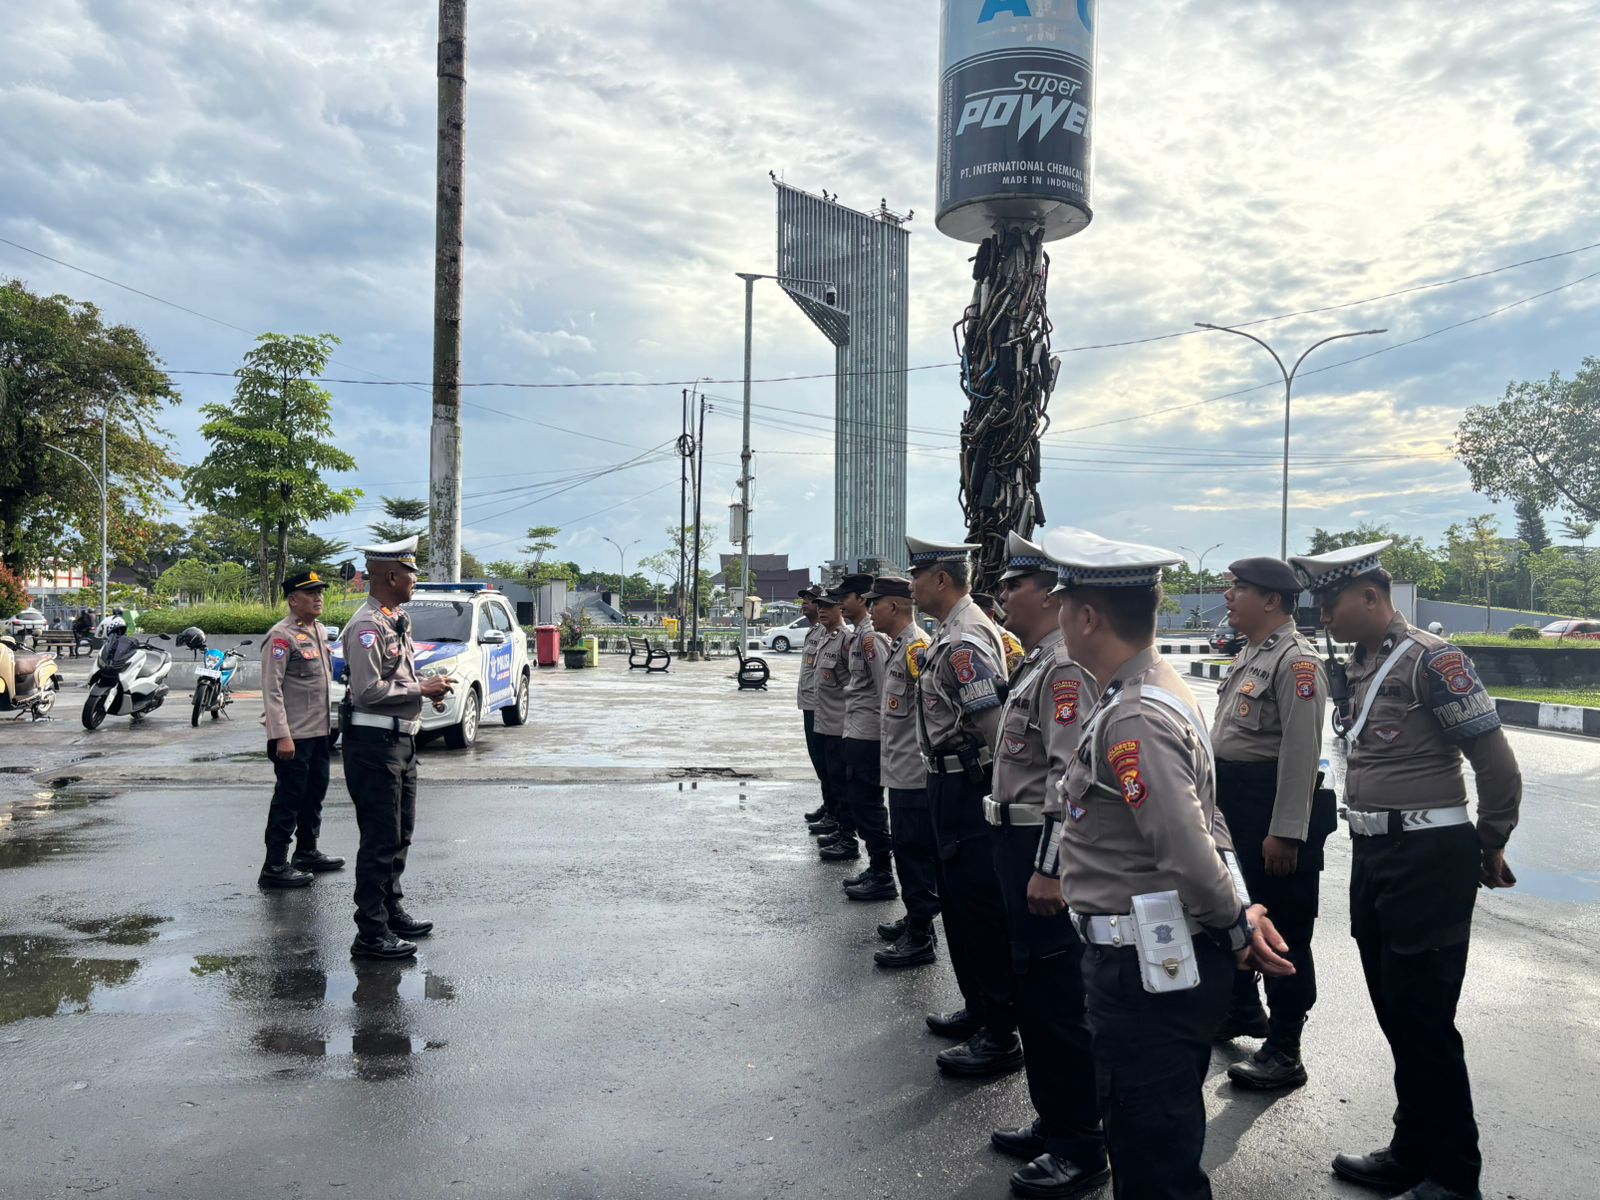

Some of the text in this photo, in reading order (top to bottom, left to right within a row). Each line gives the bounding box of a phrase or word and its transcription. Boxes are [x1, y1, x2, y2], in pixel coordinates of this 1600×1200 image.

[1012, 70, 1083, 96] Super
[960, 169, 972, 180] PT.
[973, 160, 1045, 176] INTERNATIONAL
[1047, 162, 1084, 179] CHEMICAL
[1002, 176, 1028, 185] MADE
[1032, 176, 1042, 185] IN
[1047, 177, 1084, 195] INDONESIA
[1248, 666, 1270, 680] POLRI
